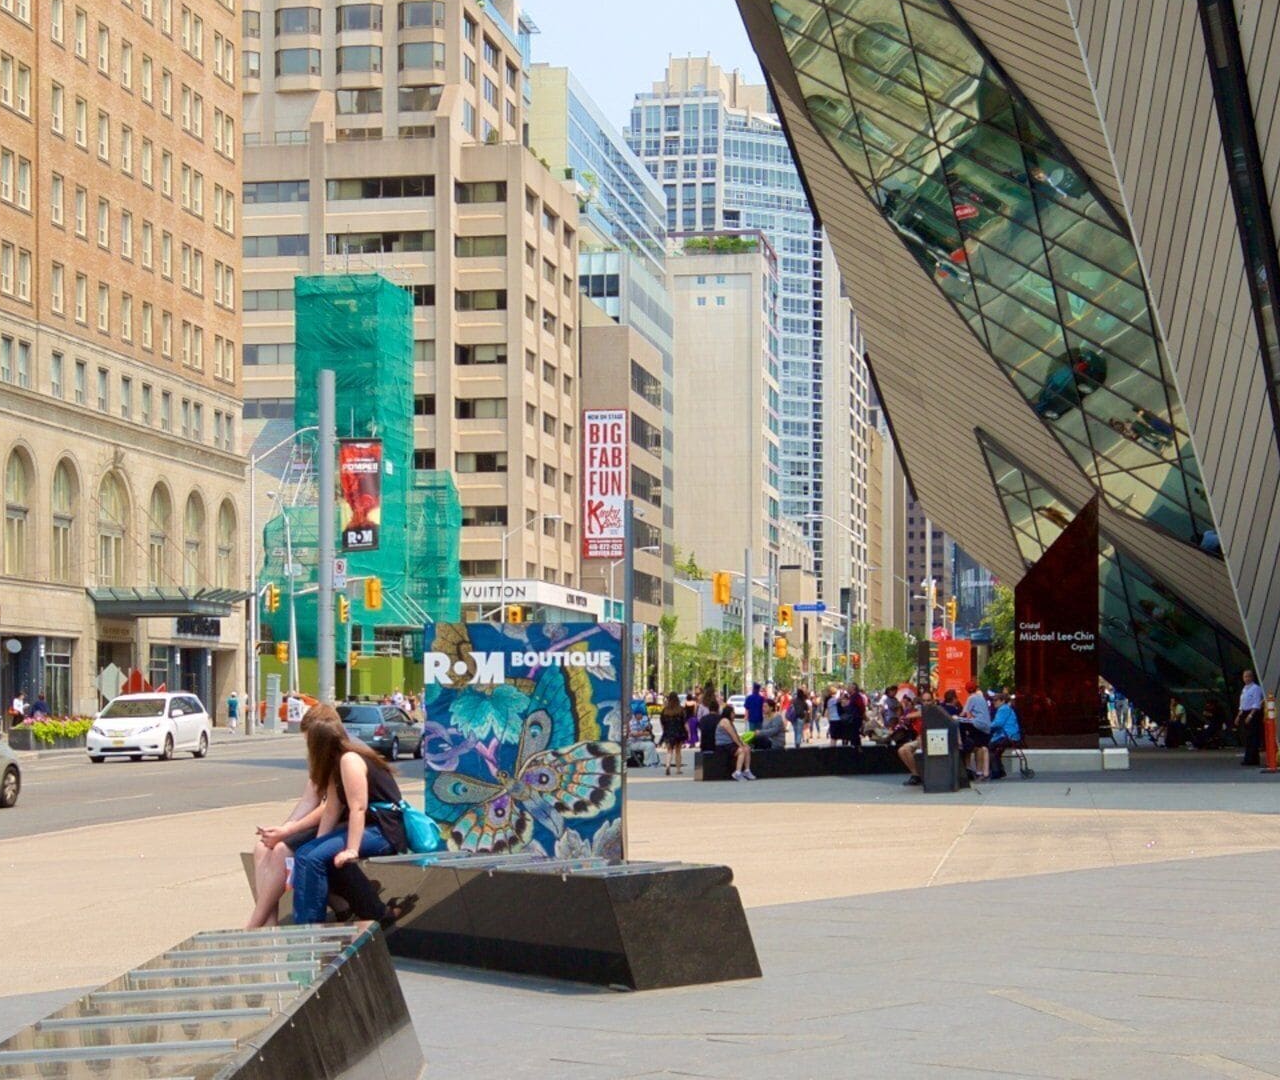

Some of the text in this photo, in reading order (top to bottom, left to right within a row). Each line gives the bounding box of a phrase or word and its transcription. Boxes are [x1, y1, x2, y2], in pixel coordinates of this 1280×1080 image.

[590, 423, 621, 444] BIG
[590, 447, 622, 468] FAB
[589, 471, 622, 496] FUN
[347, 530, 373, 544] ROM
[463, 586, 527, 598] VUITTON
[1019, 622, 1041, 630] Cristal
[1019, 631, 1095, 641] Michael Lee-Chin
[1071, 643, 1095, 652] Crystal
[424, 651, 611, 684] ROM BOUTIQUE
